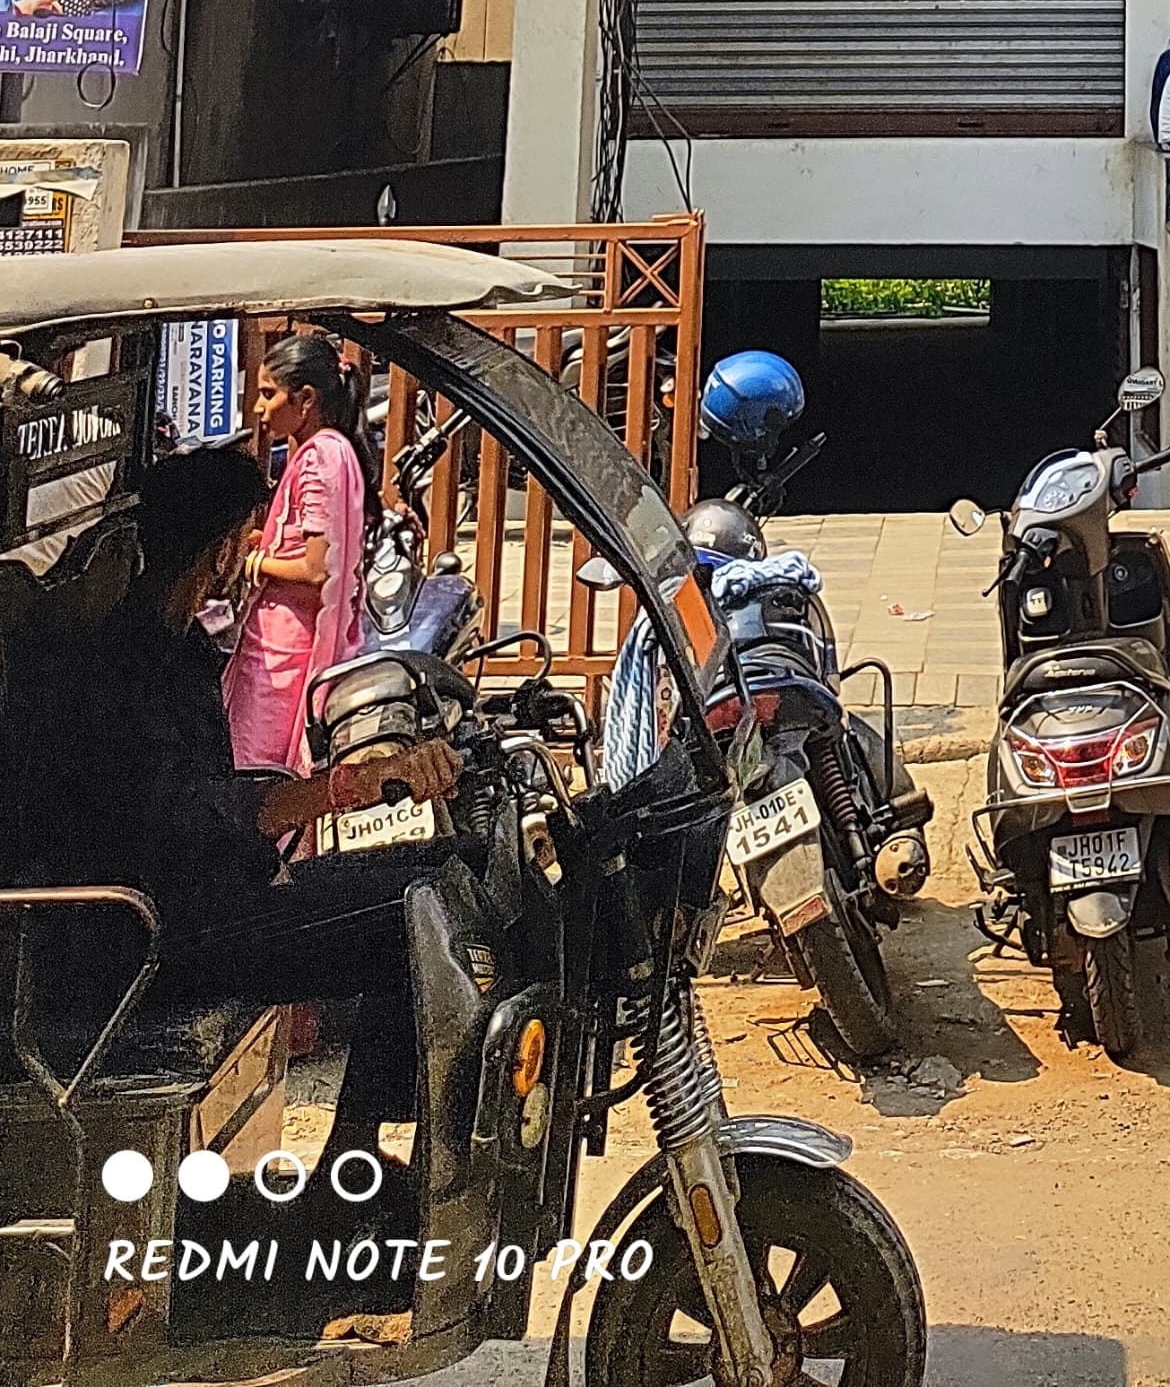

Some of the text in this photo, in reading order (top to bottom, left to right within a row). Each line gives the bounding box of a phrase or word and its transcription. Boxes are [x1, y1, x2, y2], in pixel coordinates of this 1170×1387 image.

[6, 21, 128, 45] Balaji Square,
[24, 46, 125, 66] Jharkhand.
[210, 343, 225, 428] PARKING
[346, 803, 424, 840] JH01CG
[736, 806, 809, 856] 1541
[1068, 830, 1127, 858] JH01F
[1070, 853, 1131, 880] T5942
